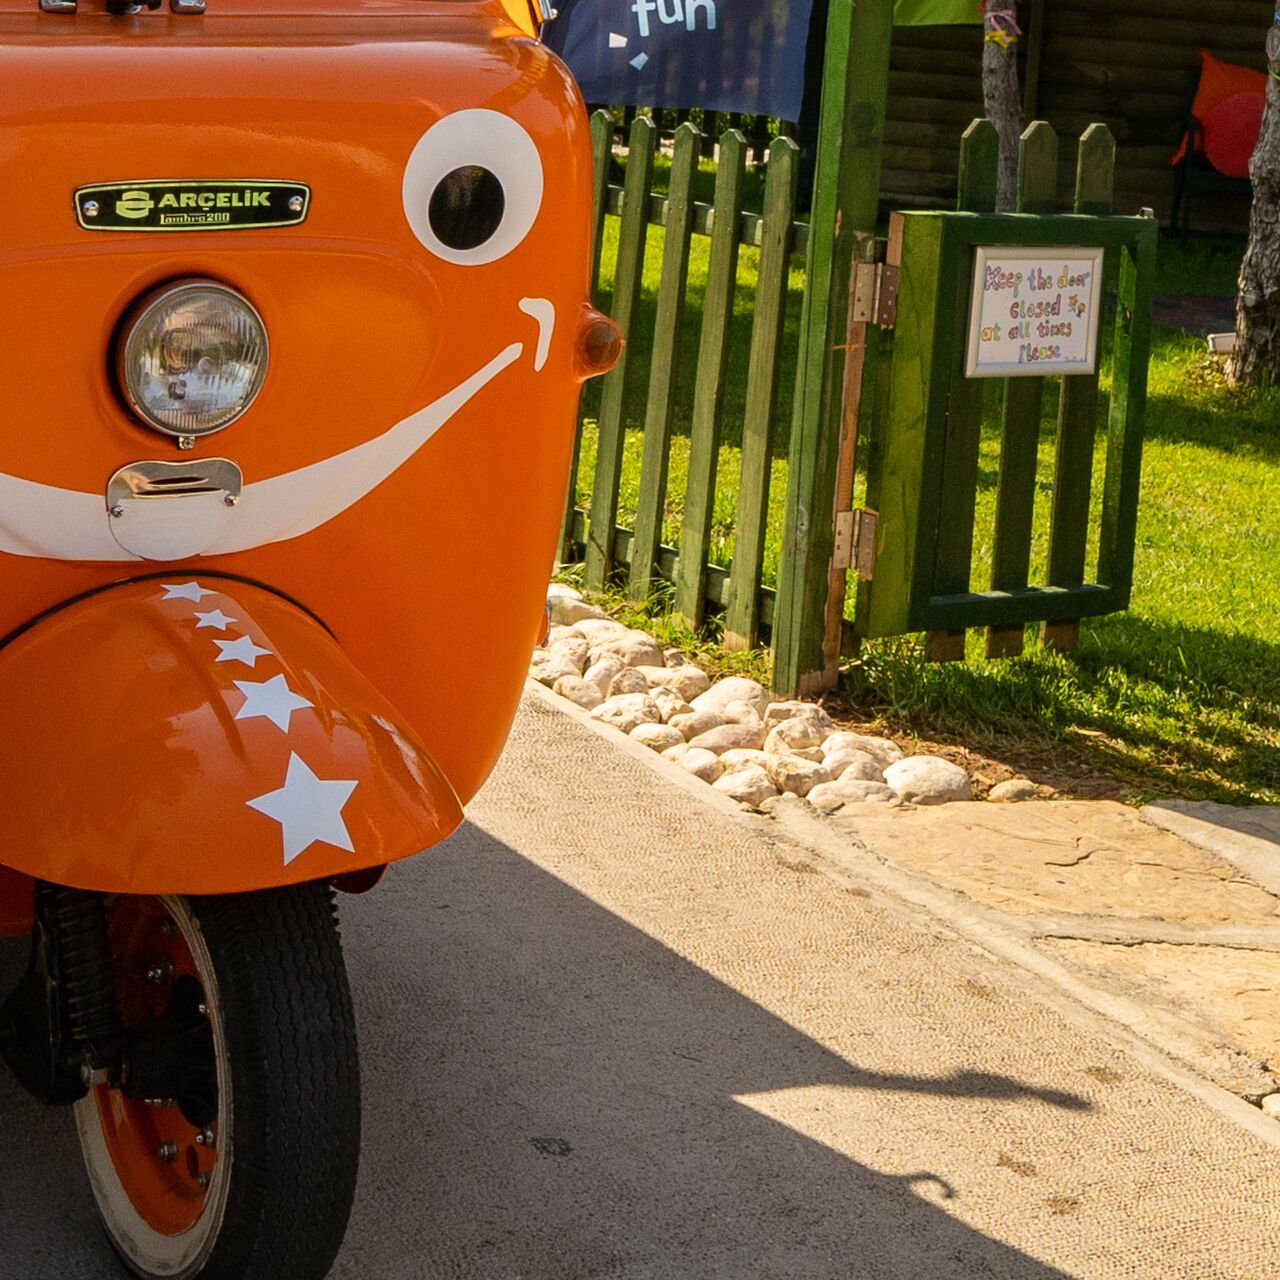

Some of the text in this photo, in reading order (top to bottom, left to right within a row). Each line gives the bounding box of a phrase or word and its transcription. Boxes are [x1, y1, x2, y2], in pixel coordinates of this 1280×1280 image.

[158, 189, 271, 211] ARÇELİK
[984, 264, 1090, 298] Keep the door
[1010, 293, 1061, 319] closed
[981, 319, 1072, 342] at all times
